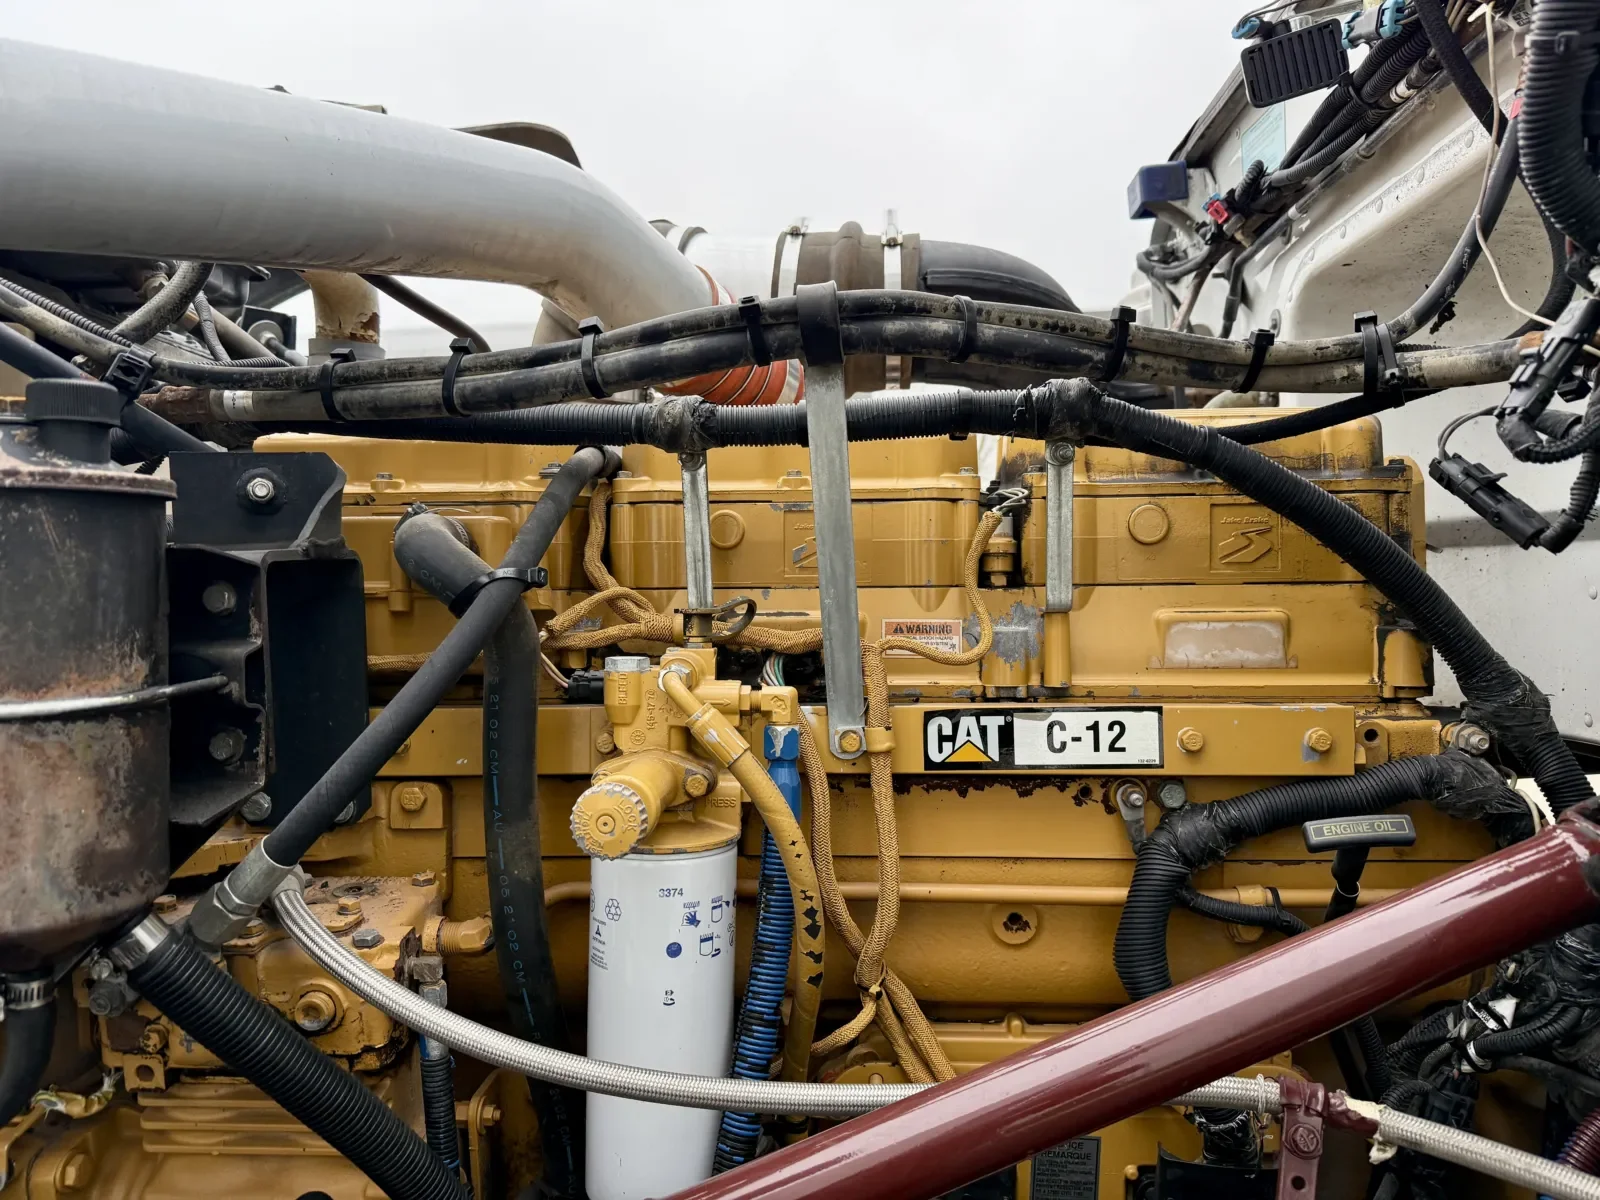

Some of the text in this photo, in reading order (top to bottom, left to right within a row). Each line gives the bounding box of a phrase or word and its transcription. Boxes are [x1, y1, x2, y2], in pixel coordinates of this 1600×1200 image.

[905, 624, 952, 635] WARNING
[618, 673, 628, 705] BLEED
[927, 715, 1005, 763] CAT
[1046, 719, 1127, 754] C-12
[705, 797, 737, 808] PRESS
[617, 798, 639, 834] LOCK
[1322, 821, 1397, 836] ENGINE OIL
[658, 888, 684, 898] 3374
